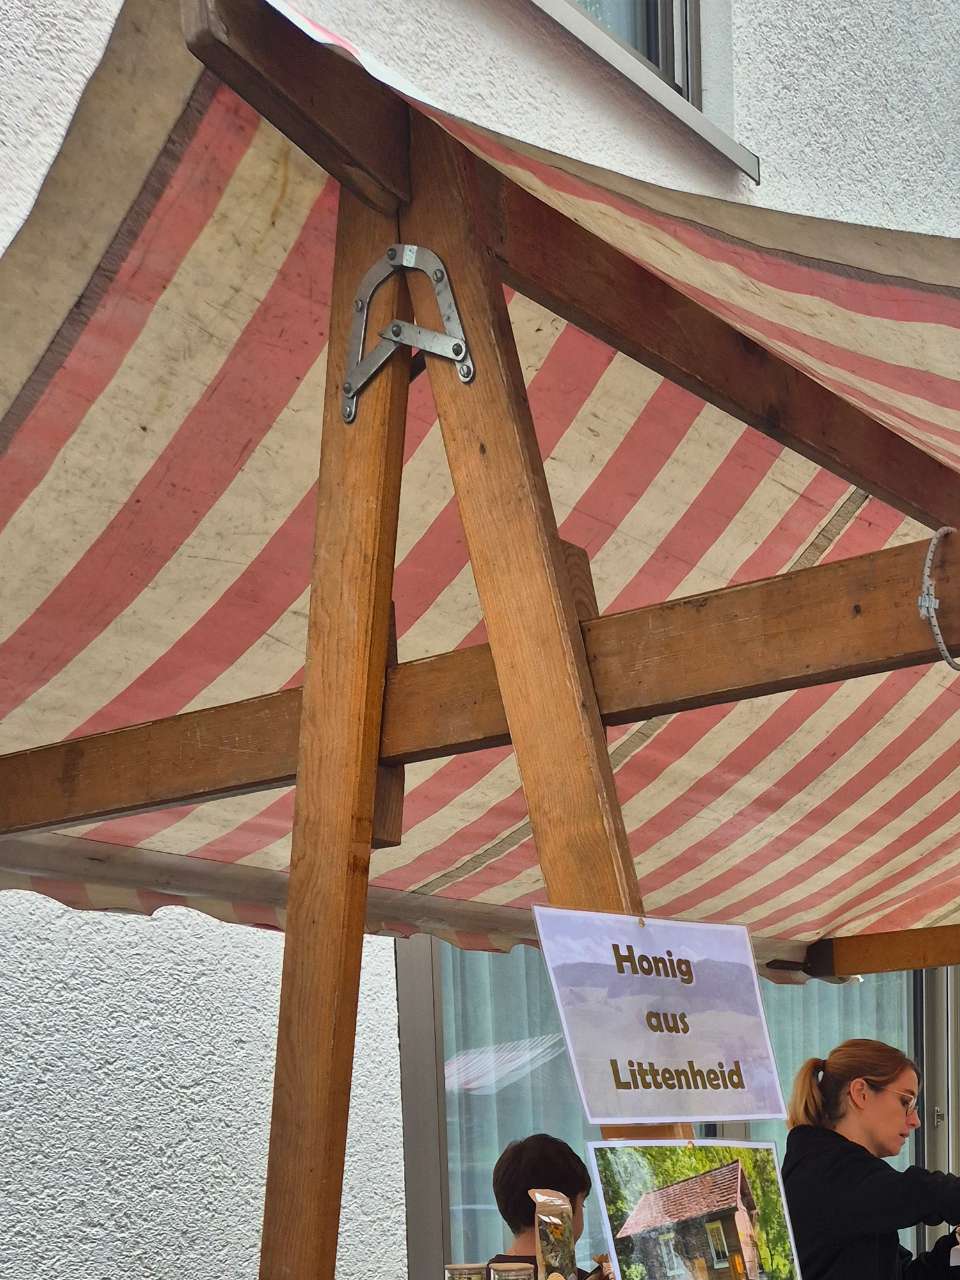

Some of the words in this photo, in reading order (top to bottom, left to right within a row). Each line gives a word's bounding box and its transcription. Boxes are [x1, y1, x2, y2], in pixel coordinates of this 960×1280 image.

[612, 944, 694, 984] Honig
[645, 1010, 690, 1034] aus
[610, 1059, 746, 1090] Littenheid
